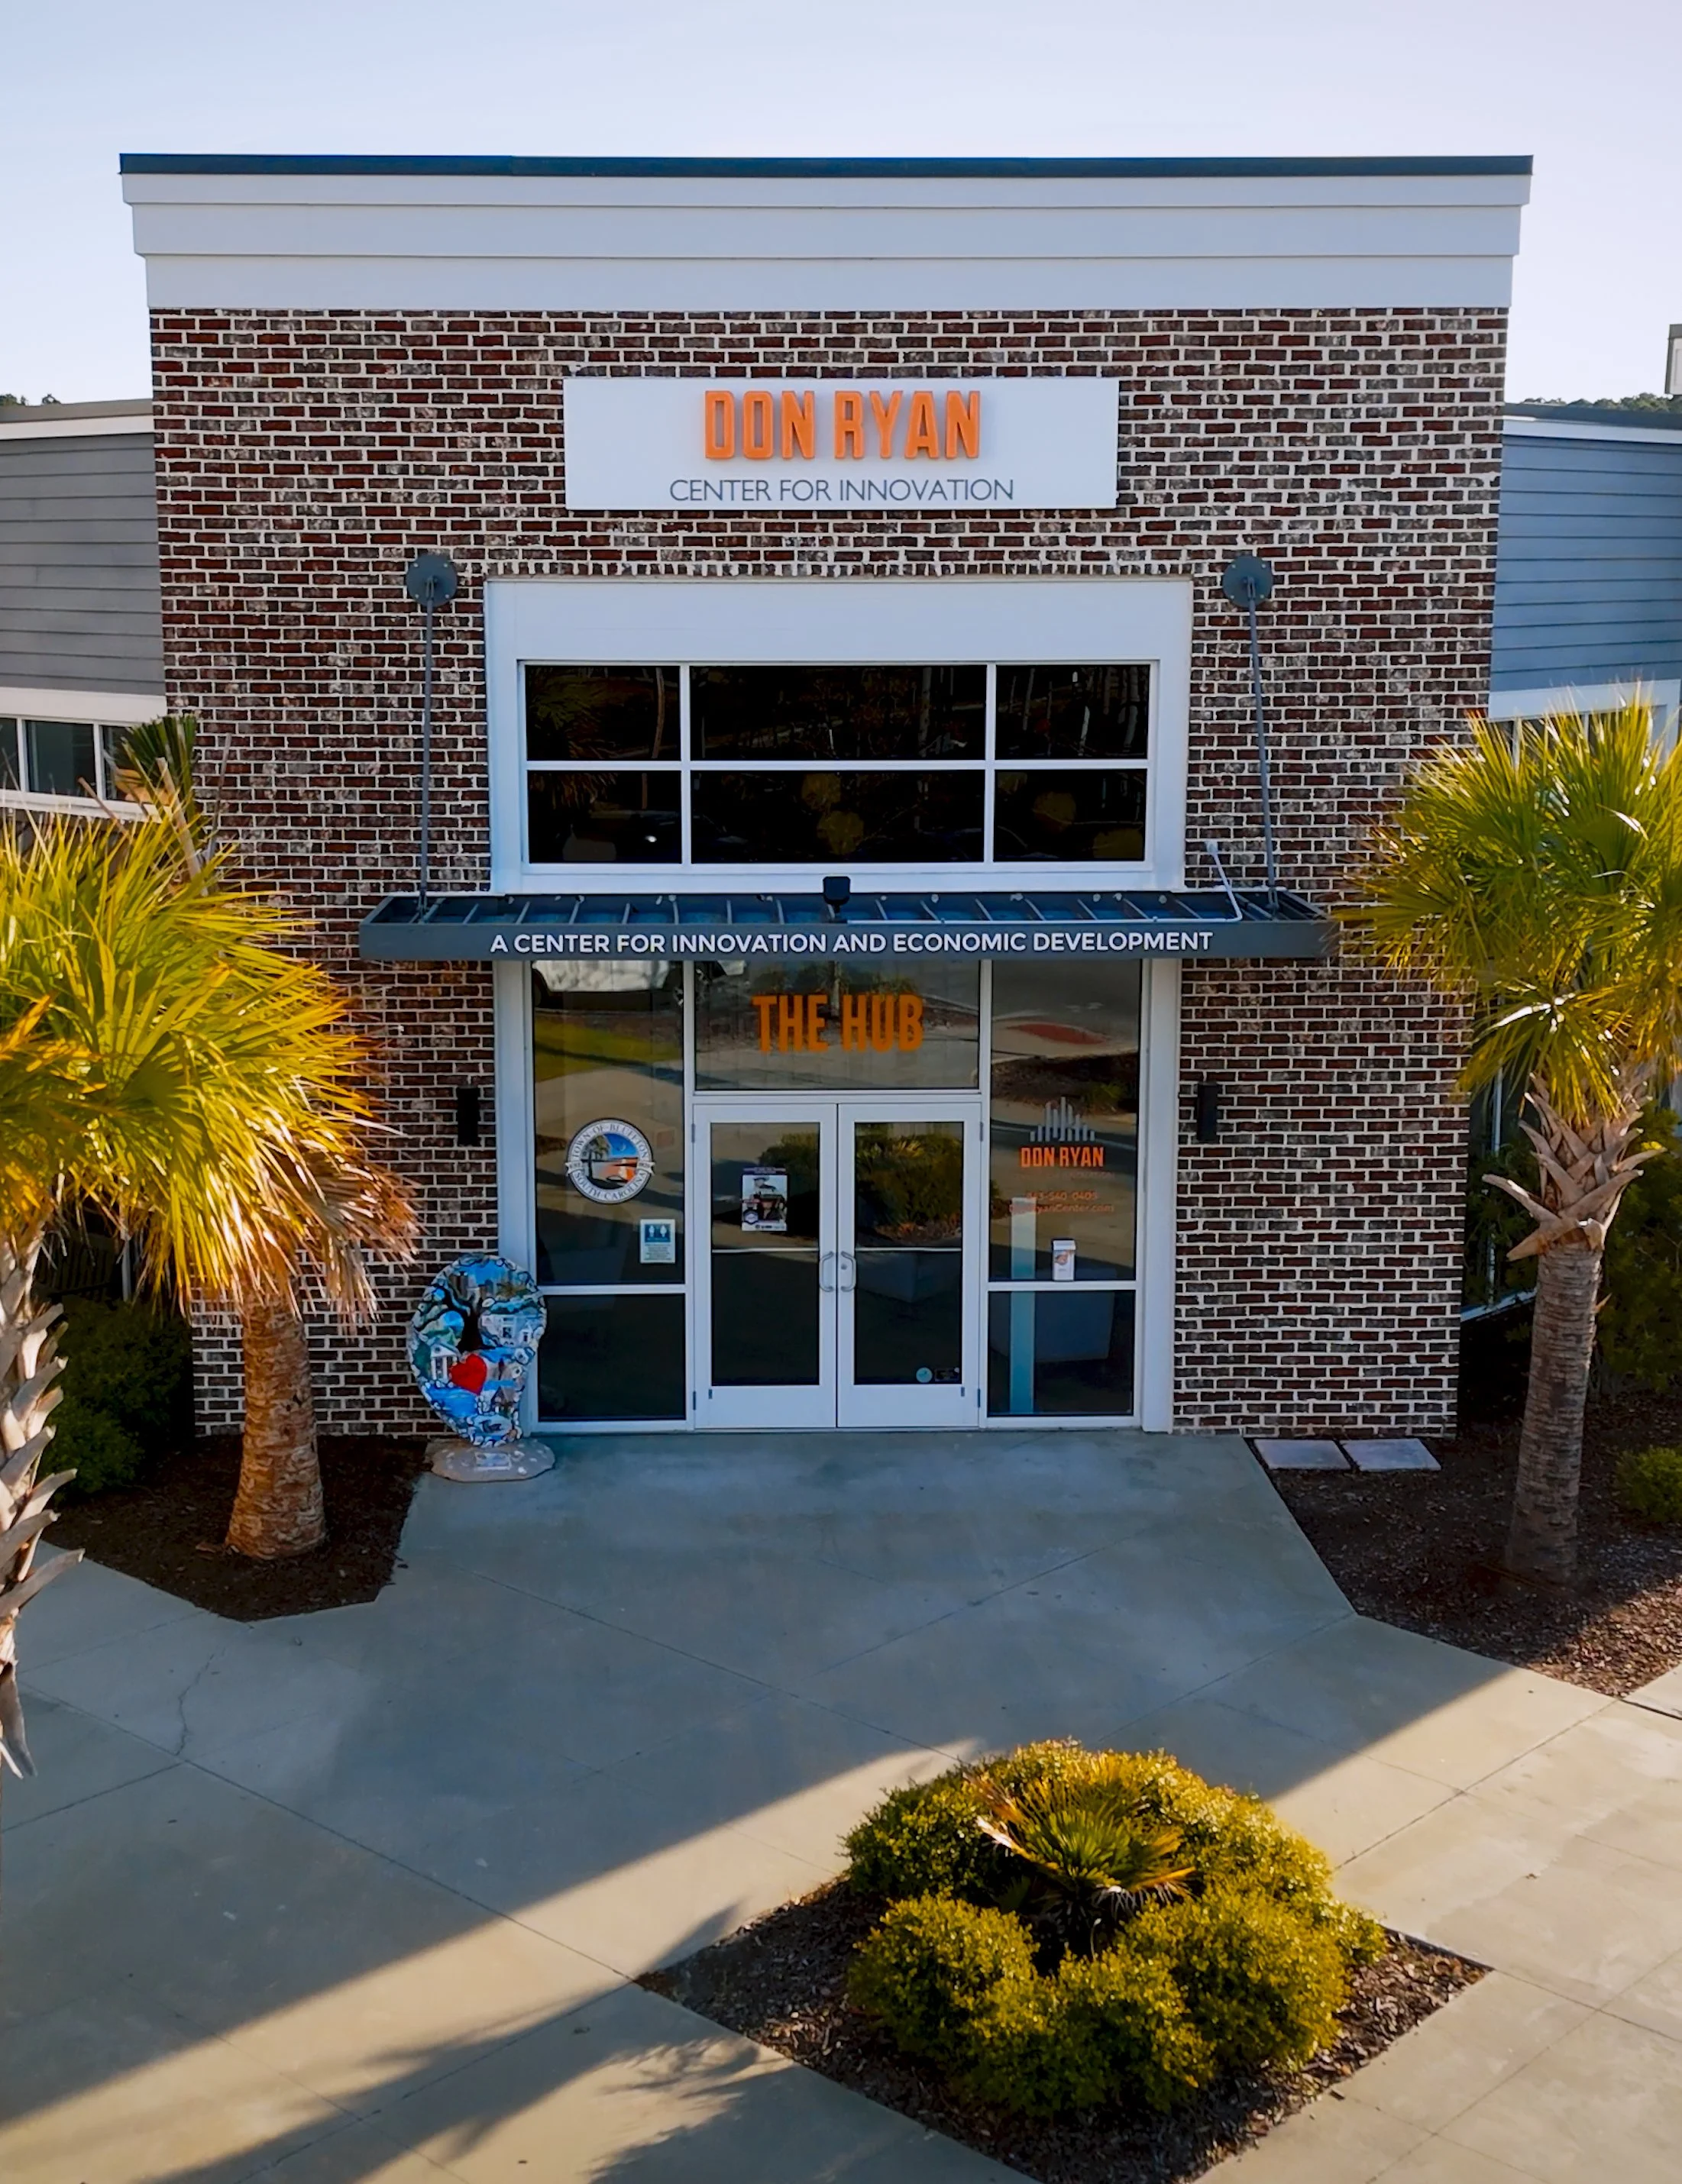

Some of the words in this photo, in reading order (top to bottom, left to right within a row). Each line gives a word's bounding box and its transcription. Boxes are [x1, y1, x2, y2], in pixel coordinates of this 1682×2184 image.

[705, 389, 815, 459] DON
[834, 389, 981, 459] RYAN
[670, 479, 771, 502] CENTER
[781, 479, 832, 502] FOR
[840, 478, 1014, 502] INNOVATION
[490, 934, 509, 953] A
[513, 934, 610, 953] CENTER
[617, 934, 665, 953] FOR
[673, 933, 826, 953] INNOVATION
[833, 933, 886, 952] AND
[894, 932, 1027, 952] ECONOMIC
[1033, 931, 1213, 951] DEVELOPMENT
[752, 994, 829, 1052] THE
[843, 994, 923, 1052] HUB
[573, 1132, 590, 1158] TOWN
[1021, 1147, 1055, 1168] DON
[1059, 1147, 1105, 1168] RYAN
[574, 1172, 601, 1199] SOUTH
[1009, 1203, 1114, 1215] RyanCenter.com
